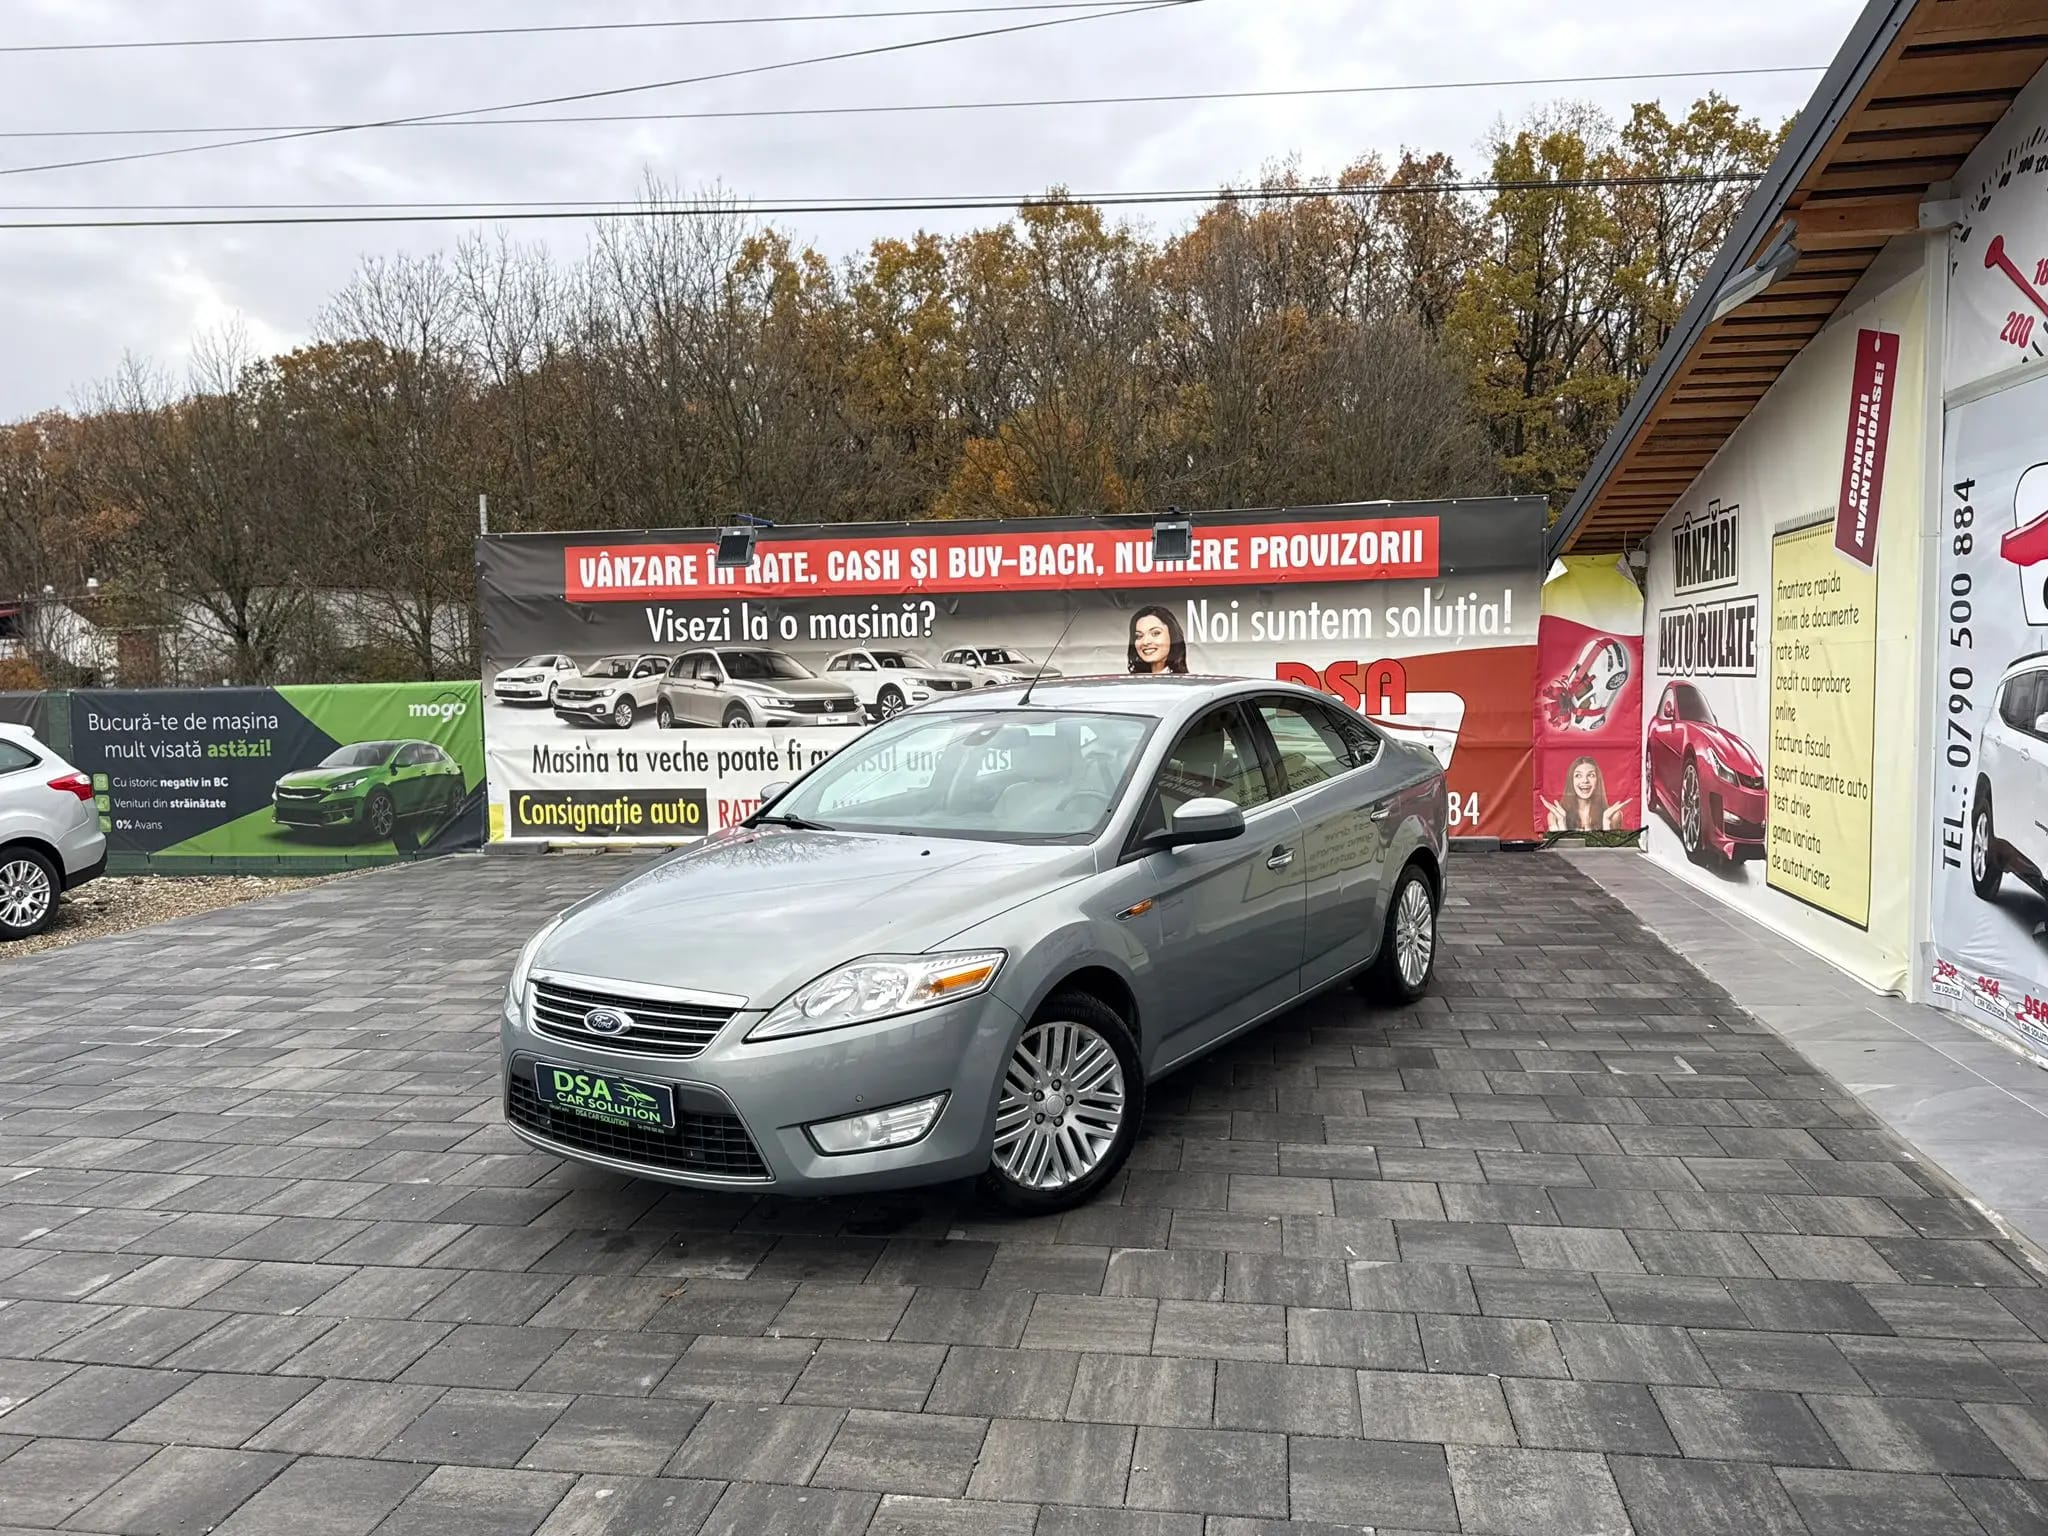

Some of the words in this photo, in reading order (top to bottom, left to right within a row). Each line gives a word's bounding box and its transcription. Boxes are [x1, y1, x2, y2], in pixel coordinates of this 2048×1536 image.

[2000, 310, 2035, 349] 200
[1848, 393, 1870, 508] CONDITII
[1854, 361, 1886, 548] AVANTAJOASE!
[1953, 477, 1976, 556] 884
[579, 551, 698, 588] VÂNZARE
[745, 551, 818, 585] RATE,
[827, 549, 900, 582] CASH
[910, 547, 938, 587] ȘI
[948, 543, 1105, 578] BUY-BACK,
[1250, 529, 1424, 570] PROVIZORII
[1674, 509, 1737, 588] VÂNZĂRI
[1777, 580, 1812, 602] finantare
[1814, 569, 1841, 602] rapida
[645, 606, 731, 643] Visezi
[741, 602, 767, 641] la
[780, 614, 798, 641] o
[1186, 599, 1240, 643] Noi
[1251, 600, 1372, 642] suntem
[1386, 587, 1512, 645] soluția!
[1776, 609, 1798, 632] minim
[1800, 608, 1810, 629] de
[1812, 603, 1860, 628] documente
[1950, 572, 1974, 649] 500
[1659, 612, 1694, 669] AUTO
[1697, 604, 1756, 669] RULATE
[1776, 642, 1792, 660] rate
[1795, 639, 1810, 661] fixe
[1776, 670, 1799, 692] credit
[1801, 677, 1810, 692] cu
[1812, 670, 1851, 698] aprobare
[88, 713, 179, 731] Bucură-te
[184, 712, 207, 731] de
[212, 711, 279, 734] mașina
[408, 702, 467, 724] mogo
[1775, 701, 1797, 722] online
[1946, 666, 1975, 768] 0790
[105, 741, 147, 758] mult
[150, 740, 201, 758] visată
[207, 738, 272, 758] astăzi!
[617, 747, 638, 772] ta
[646, 739, 709, 773] veche
[717, 745, 779, 779] poate
[786, 738, 802, 771] fi
[1775, 729, 1803, 754] factura
[1805, 733, 1831, 759] fiscala
[112, 777, 127, 787] Cu
[129, 776, 158, 787] istoric
[160, 776, 199, 791] negativ
[214, 776, 229, 788] BC
[1774, 764, 1798, 787] suport
[1800, 763, 1845, 795] documente
[1847, 777, 1868, 800] auto
[114, 798, 151, 809] Venituri
[152, 797, 169, 809] din
[518, 794, 643, 833] Consignație
[650, 798, 700, 825] auto
[1774, 792, 1788, 812] test
[1791, 794, 1811, 819] drive
[116, 819, 133, 830] 0%
[134, 820, 163, 830] Avans
[1772, 825, 1791, 844] gama
[1793, 831, 1821, 854] variata
[1942, 784, 1968, 870] TEL.:
[1772, 848, 1781, 869] de
[1782, 856, 1831, 890] autoturisme
[553, 1070, 613, 1101] DSA
[556, 1092, 585, 1107] CAR
[588, 1098, 661, 1123] SOLUTION
[575, 1109, 588, 1118] DSA
[588, 1111, 600, 1121] CAR
[600, 1113, 630, 1127] SOLUTION
